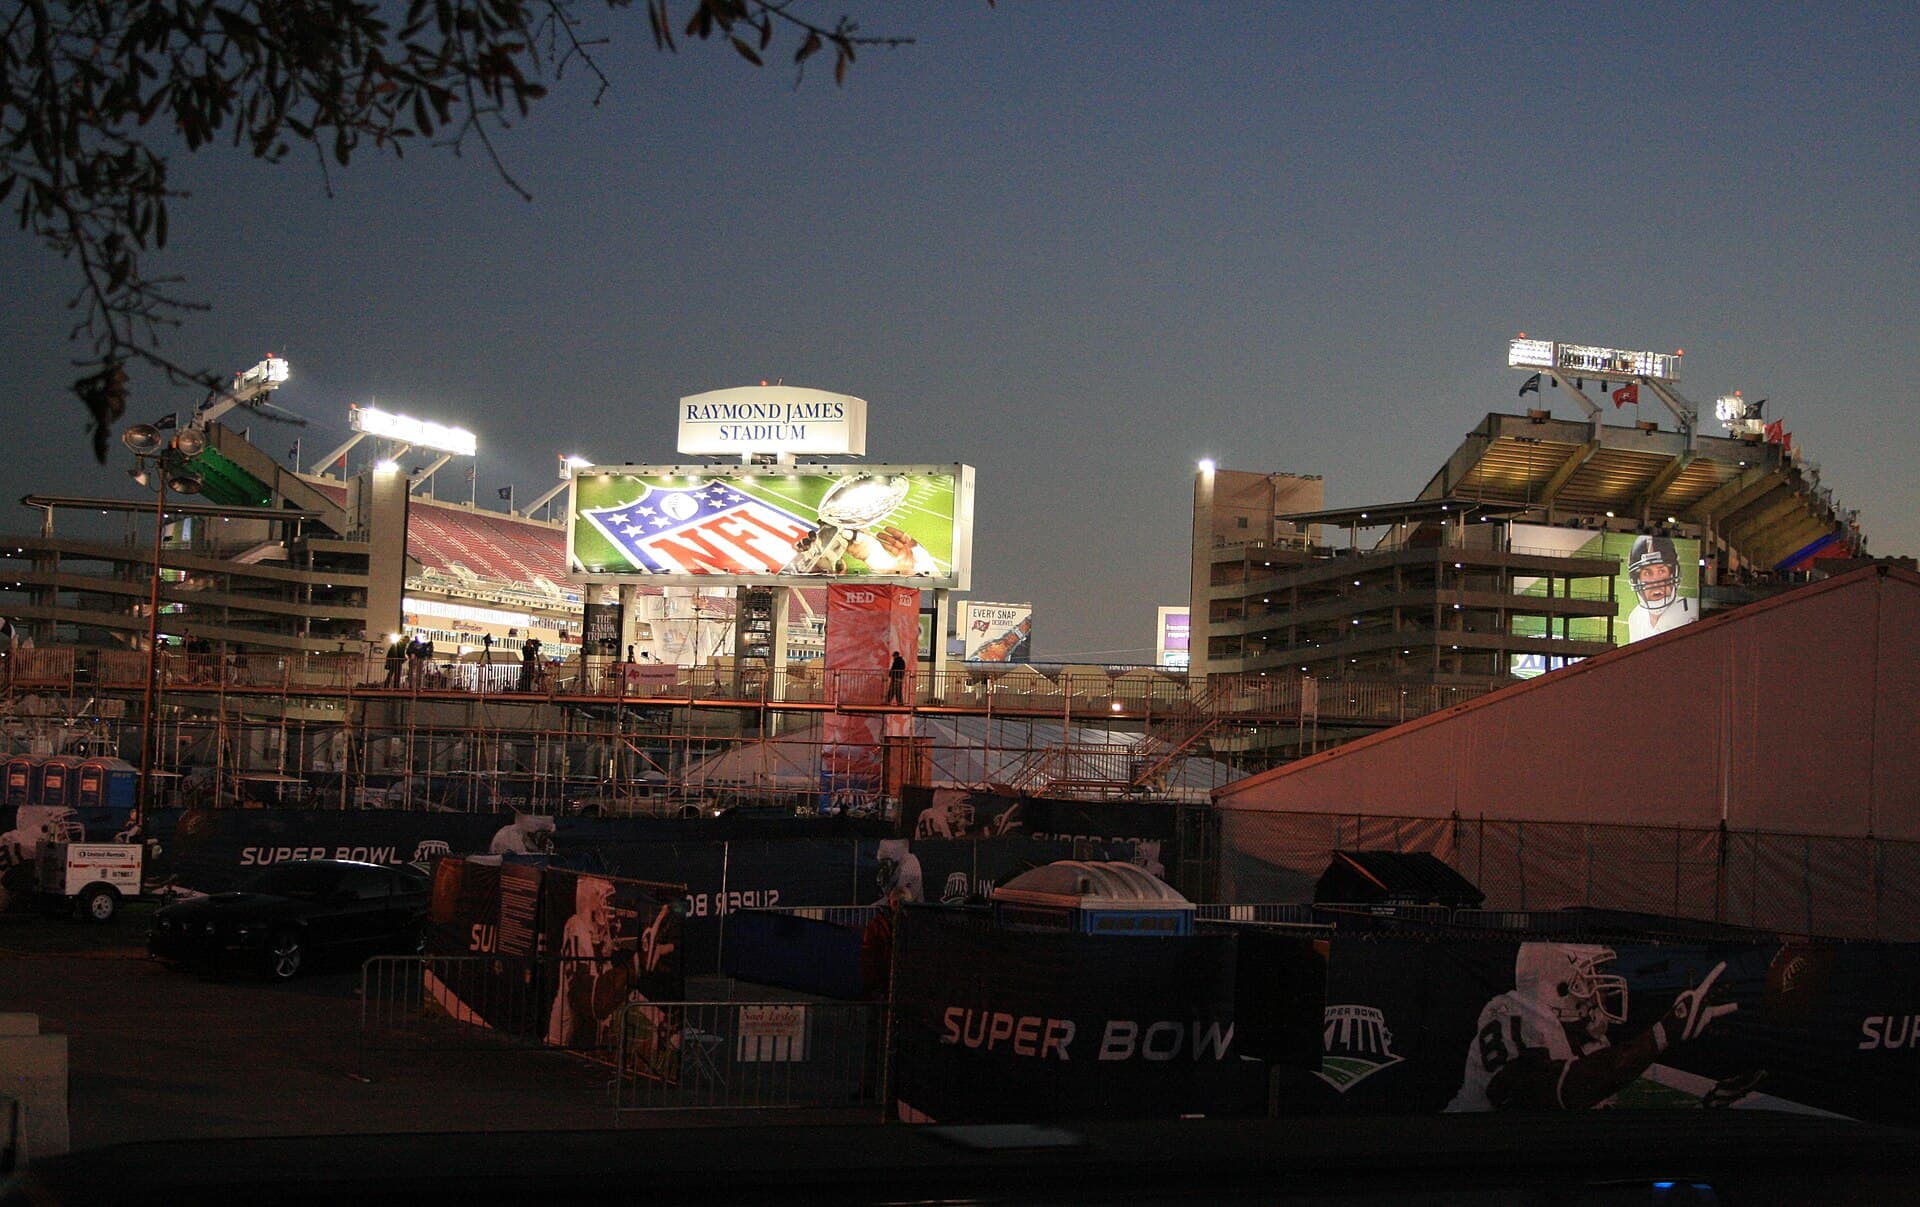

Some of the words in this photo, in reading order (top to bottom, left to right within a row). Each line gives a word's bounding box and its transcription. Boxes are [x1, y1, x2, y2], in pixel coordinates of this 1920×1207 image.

[687, 404, 780, 420] RAYMOND
[783, 403, 843, 423] JAMES
[719, 425, 806, 440] STADIUM
[648, 509, 807, 575] NFL
[595, 615, 612, 624] THE
[972, 608, 996, 618] EVERY
[997, 610, 1017, 620] SNAP
[590, 623, 615, 632] TAMPA
[239, 847, 326, 865] SUPER
[335, 846, 403, 864] BOWL
[470, 923, 496, 953] SU
[1325, 1007, 1351, 1016] UPER
[943, 1006, 1077, 1060] SUPER
[1098, 1019, 1236, 1061] BOW
